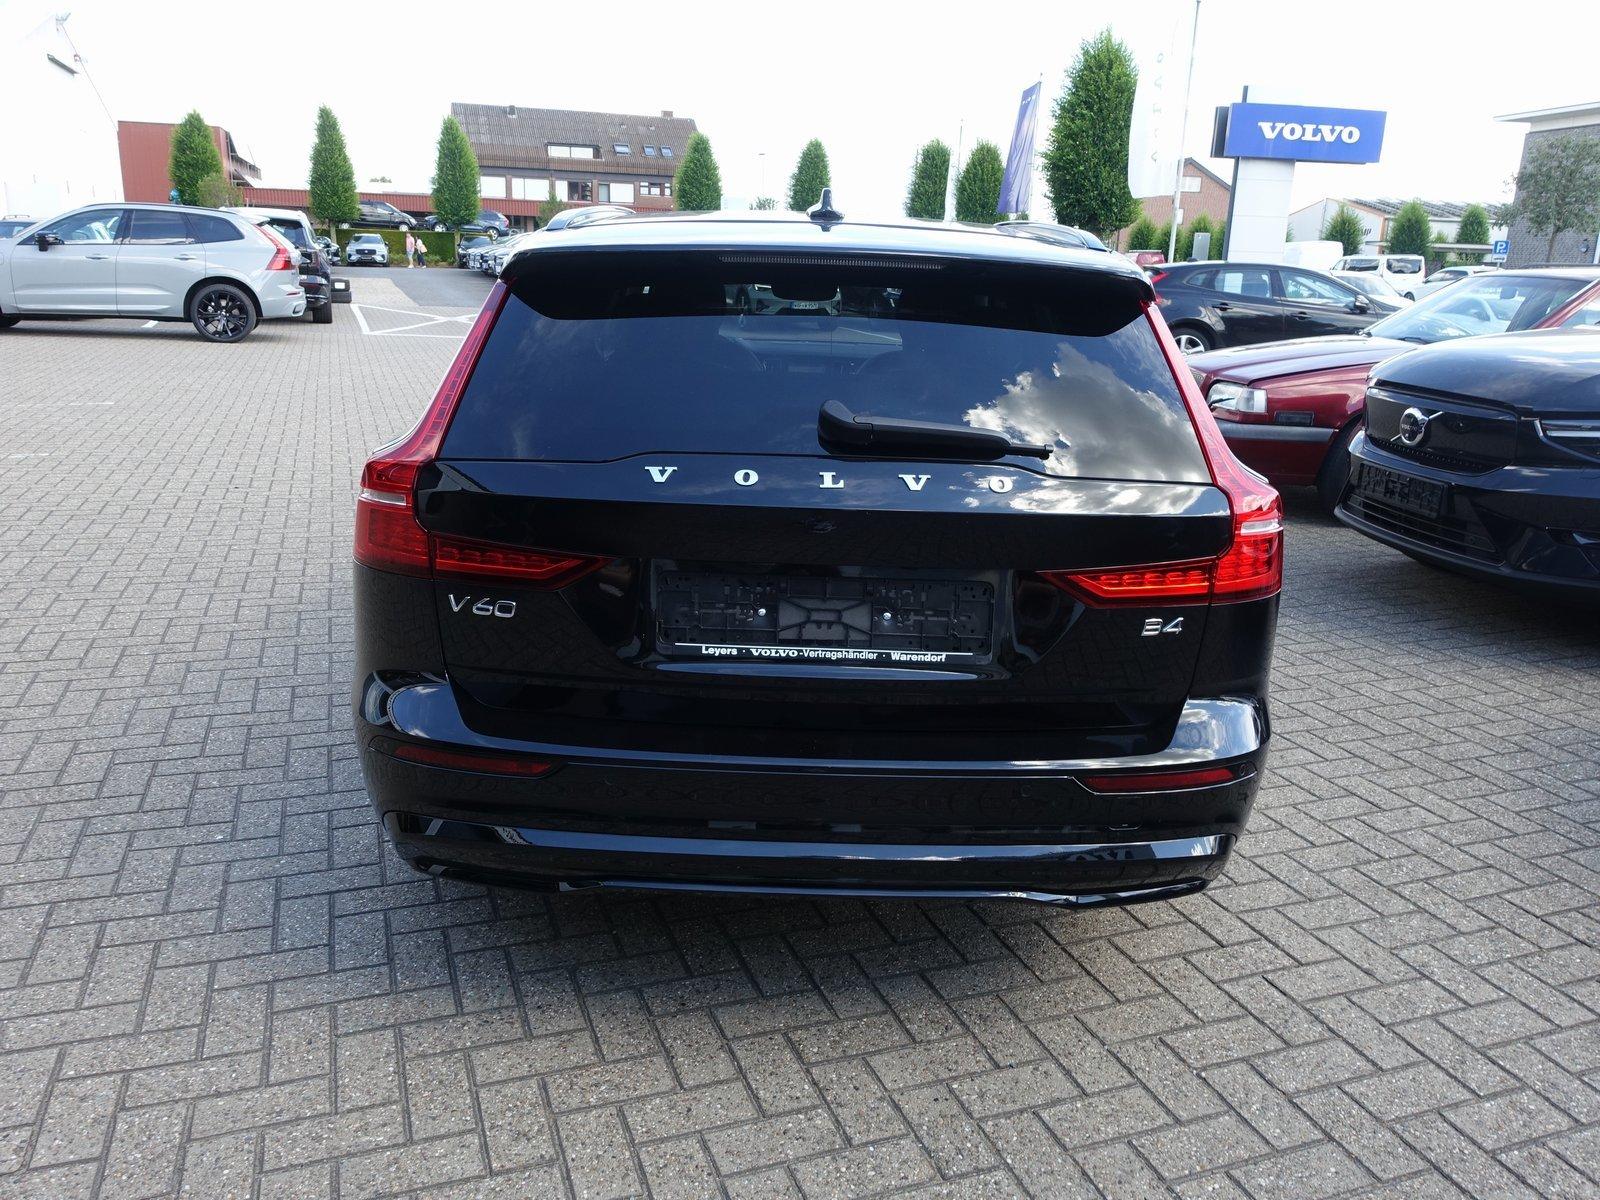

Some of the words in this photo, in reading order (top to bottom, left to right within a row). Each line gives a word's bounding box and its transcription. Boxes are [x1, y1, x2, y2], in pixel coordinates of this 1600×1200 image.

[1257, 121, 1361, 144] VOLVO
[644, 466, 1014, 493] VOLVO
[448, 594, 517, 618] V60
[1141, 617, 1184, 637] B4
[701, 645, 738, 657] Leyers
[891, 652, 946, 662] Warendorf
